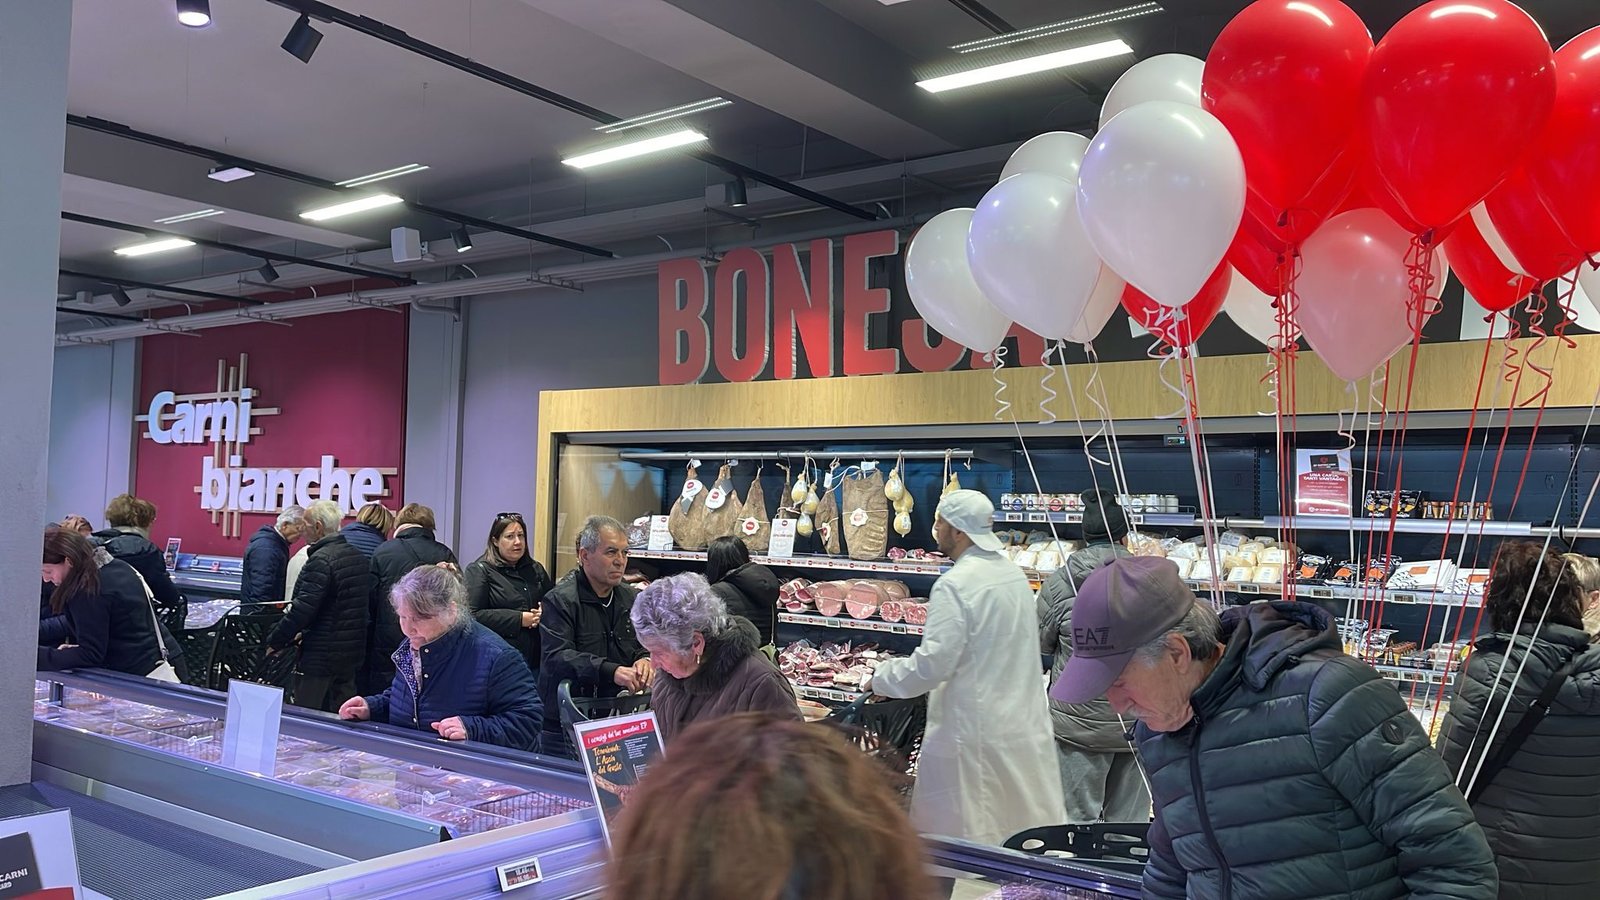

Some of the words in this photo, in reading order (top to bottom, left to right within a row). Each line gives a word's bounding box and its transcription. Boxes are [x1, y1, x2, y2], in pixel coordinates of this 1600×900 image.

[148, 387, 252, 444] Carni
[201, 455, 384, 515] bianche
[1074, 627, 1110, 645] EA7
